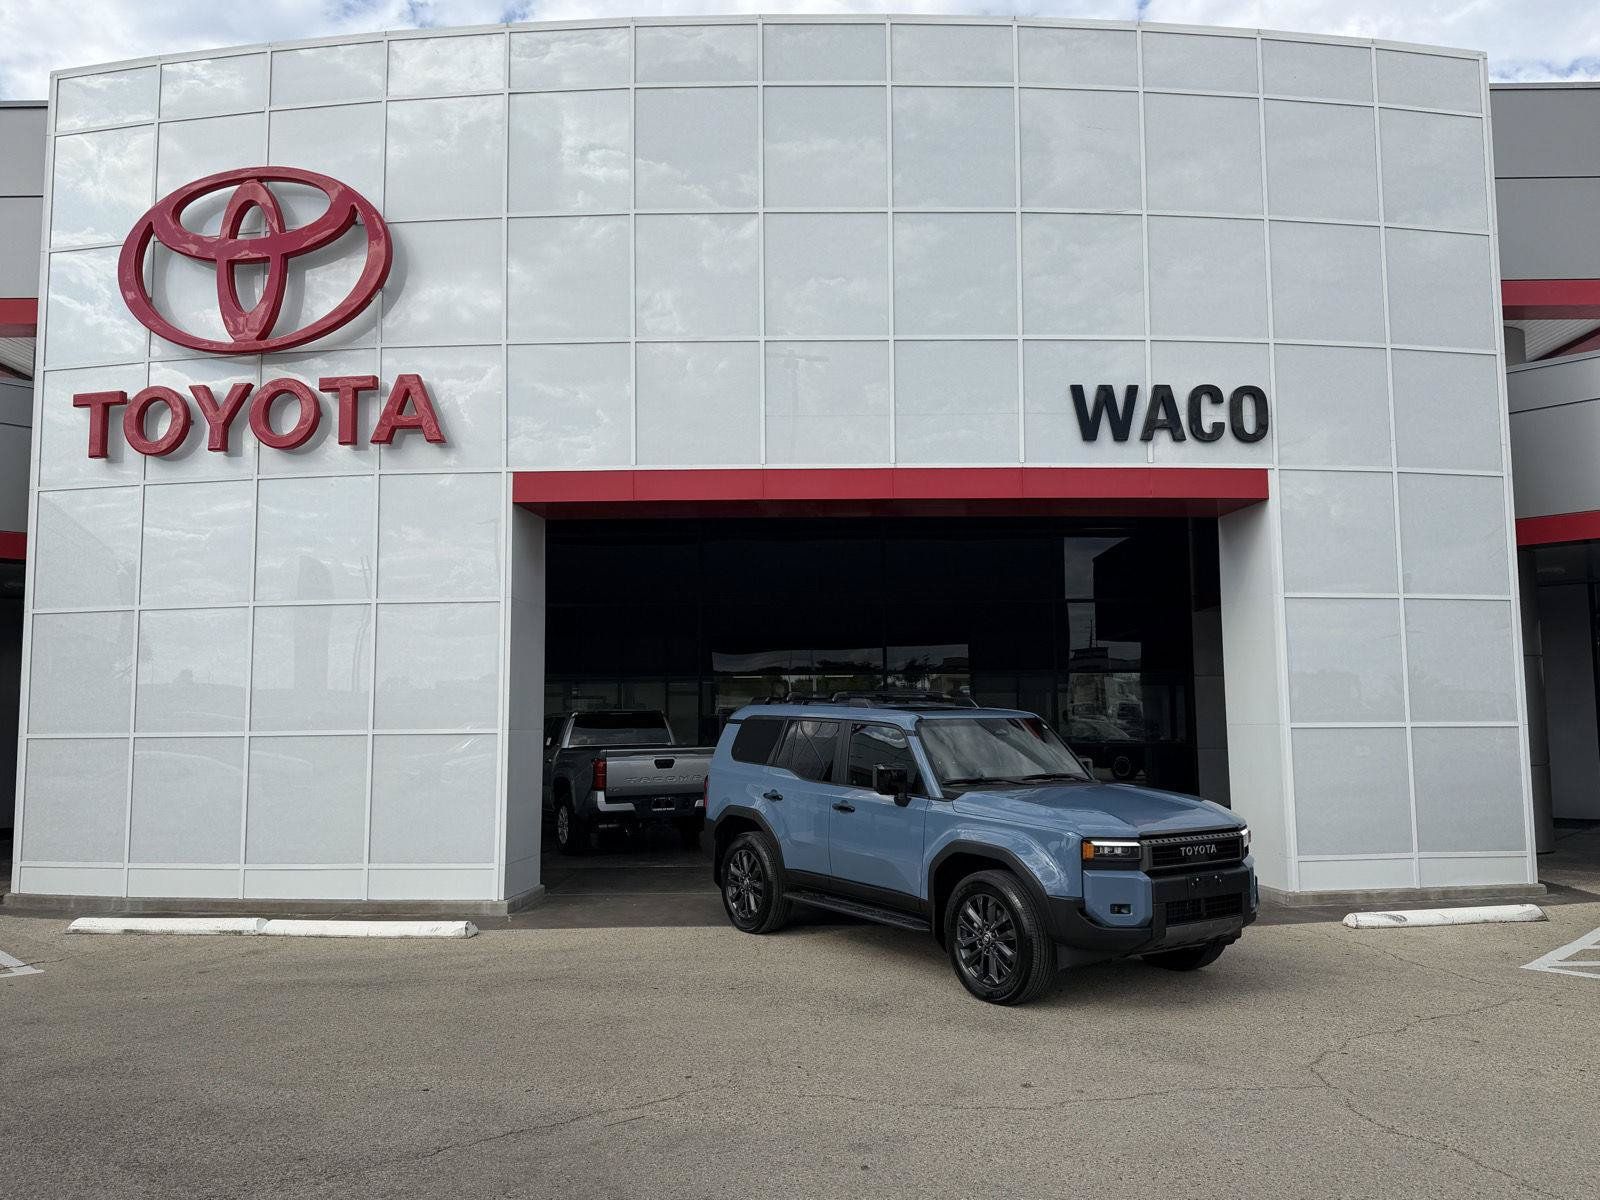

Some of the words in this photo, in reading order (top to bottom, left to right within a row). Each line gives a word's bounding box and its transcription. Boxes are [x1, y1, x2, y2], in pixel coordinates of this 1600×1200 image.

[73, 373, 447, 459] TOYOTA
[1070, 384, 1269, 443] WACO
[1180, 844, 1217, 857] TOYOTA
